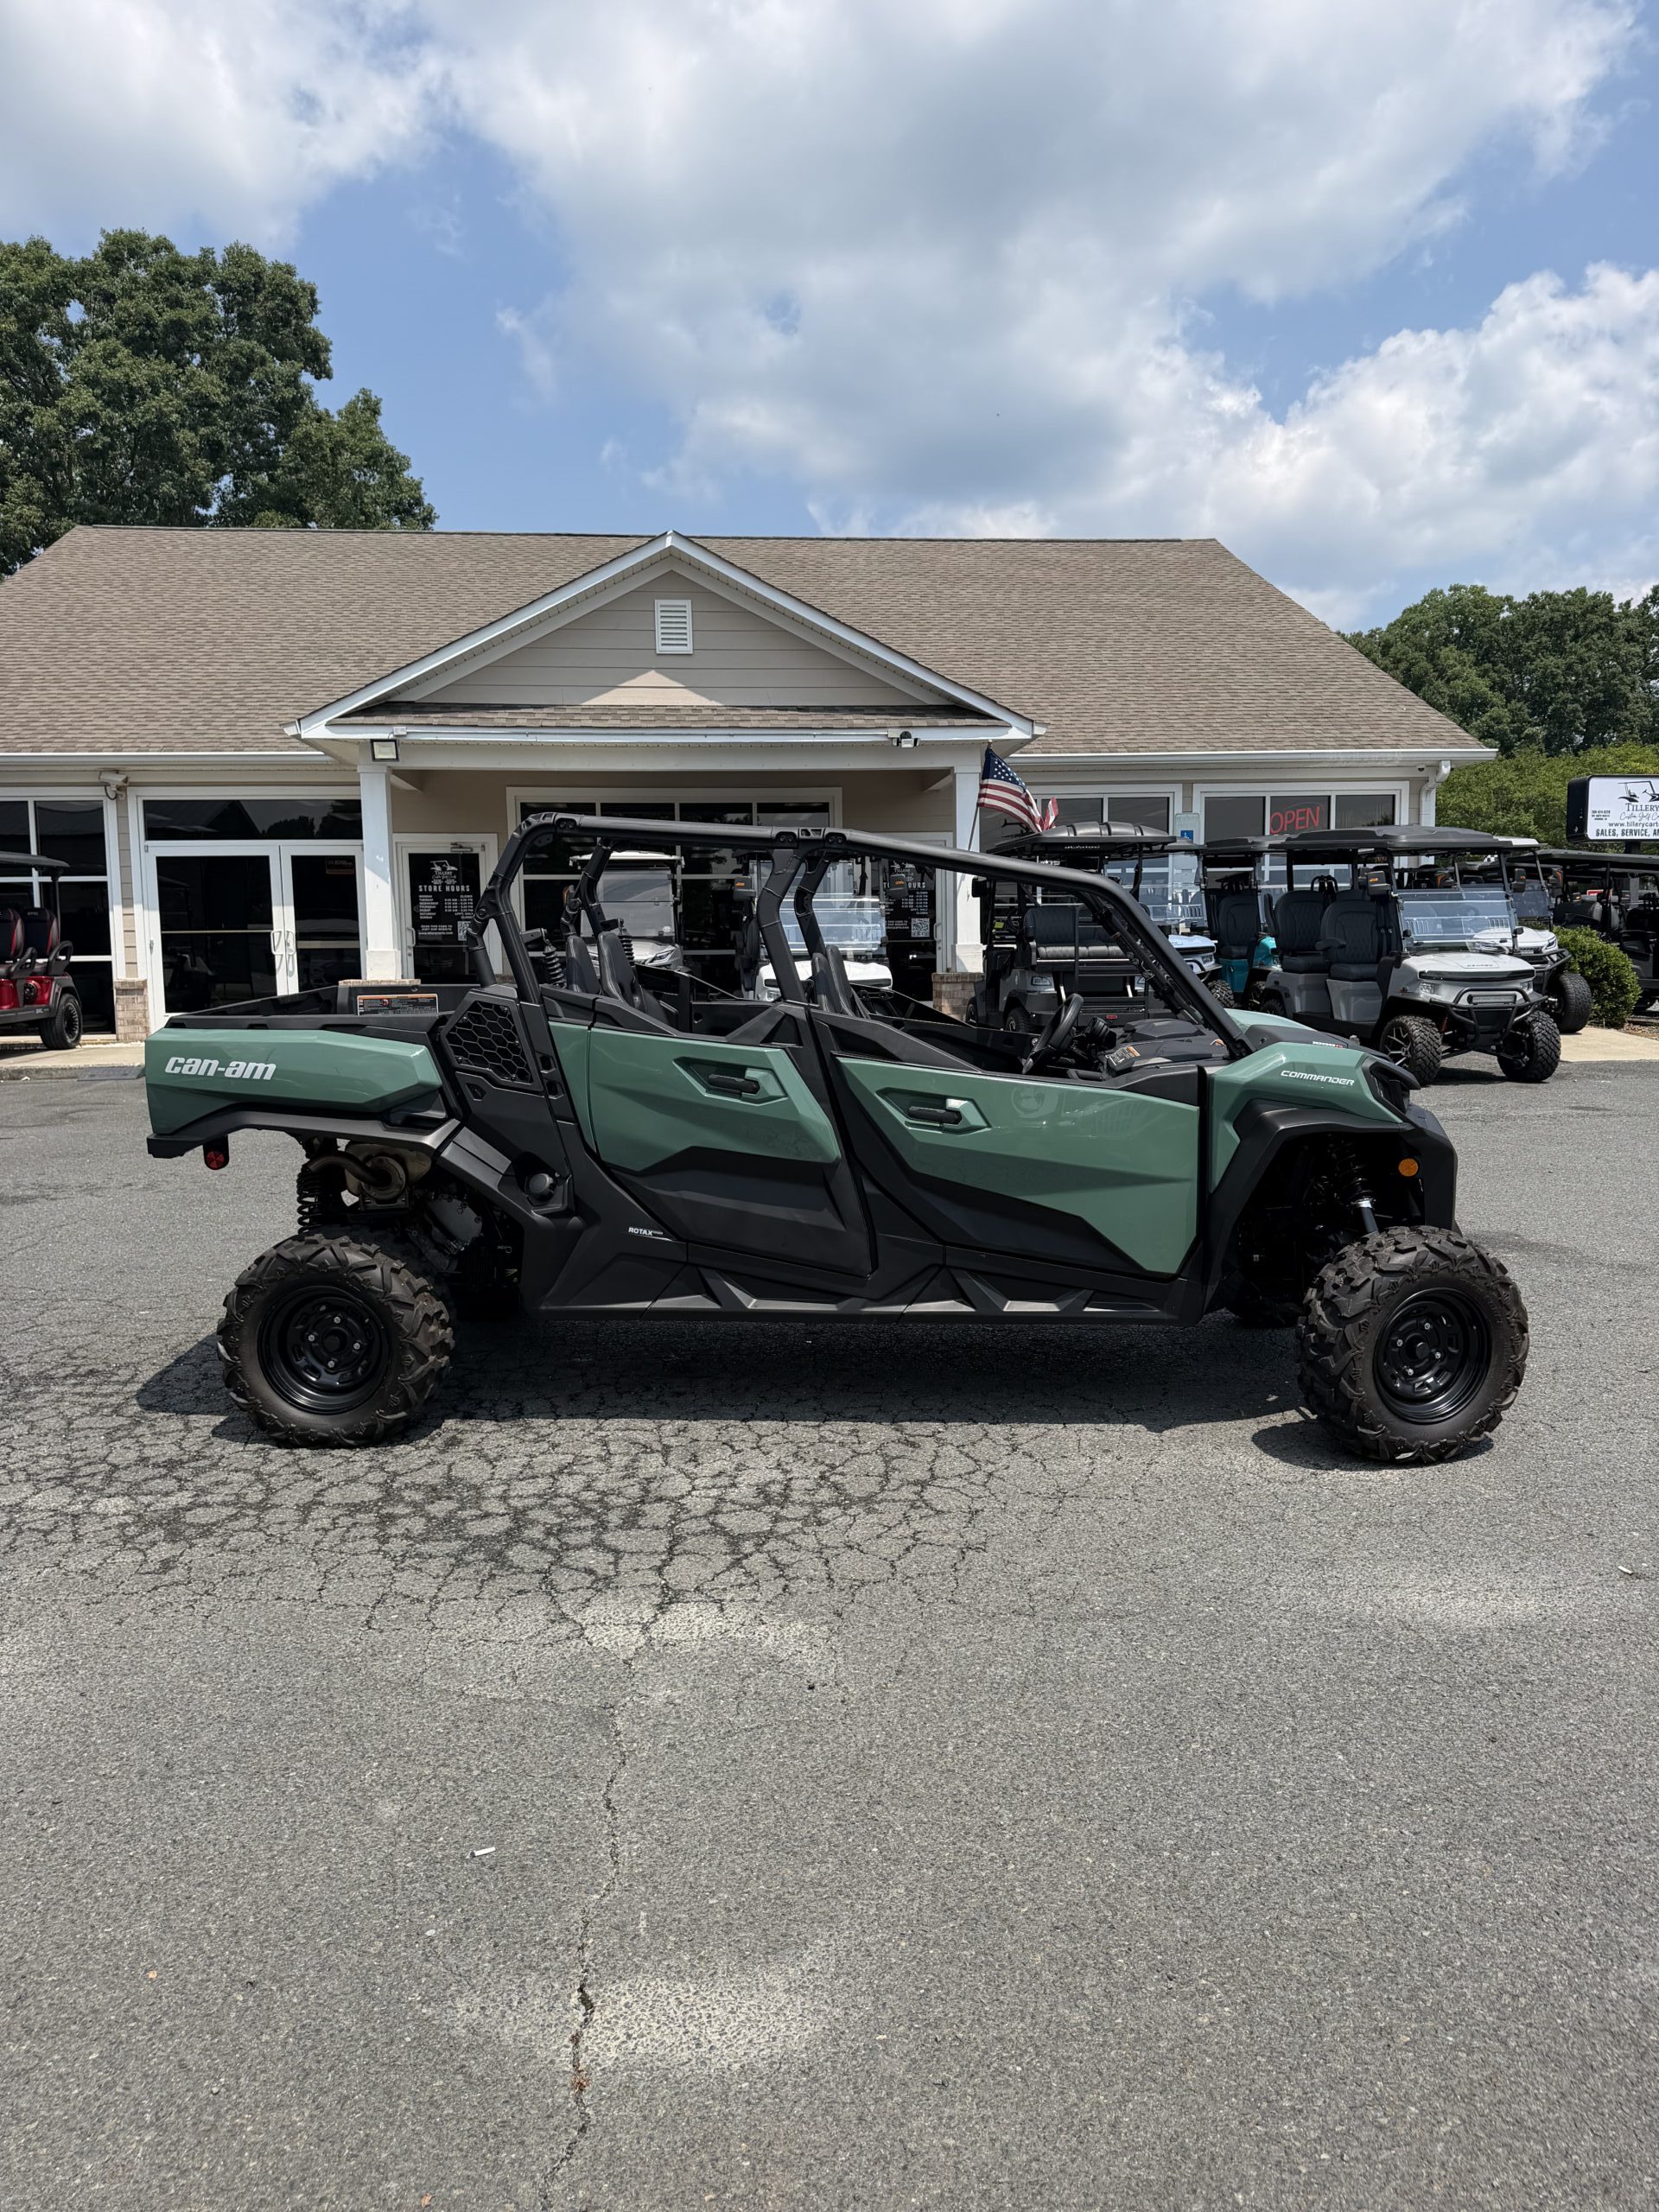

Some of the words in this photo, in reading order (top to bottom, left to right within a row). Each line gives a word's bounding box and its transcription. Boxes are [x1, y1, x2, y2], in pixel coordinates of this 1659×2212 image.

[1625, 803, 1659, 811] TILLERY
[1269, 805, 1320, 835] OPEN
[1596, 829, 1618, 837] SALES,
[1621, 829, 1650, 837] SERVICE,
[165, 1056, 276, 1081] can-am
[1281, 1070, 1355, 1086] COMMANDER
[628, 1227, 653, 1236] ROTAX
